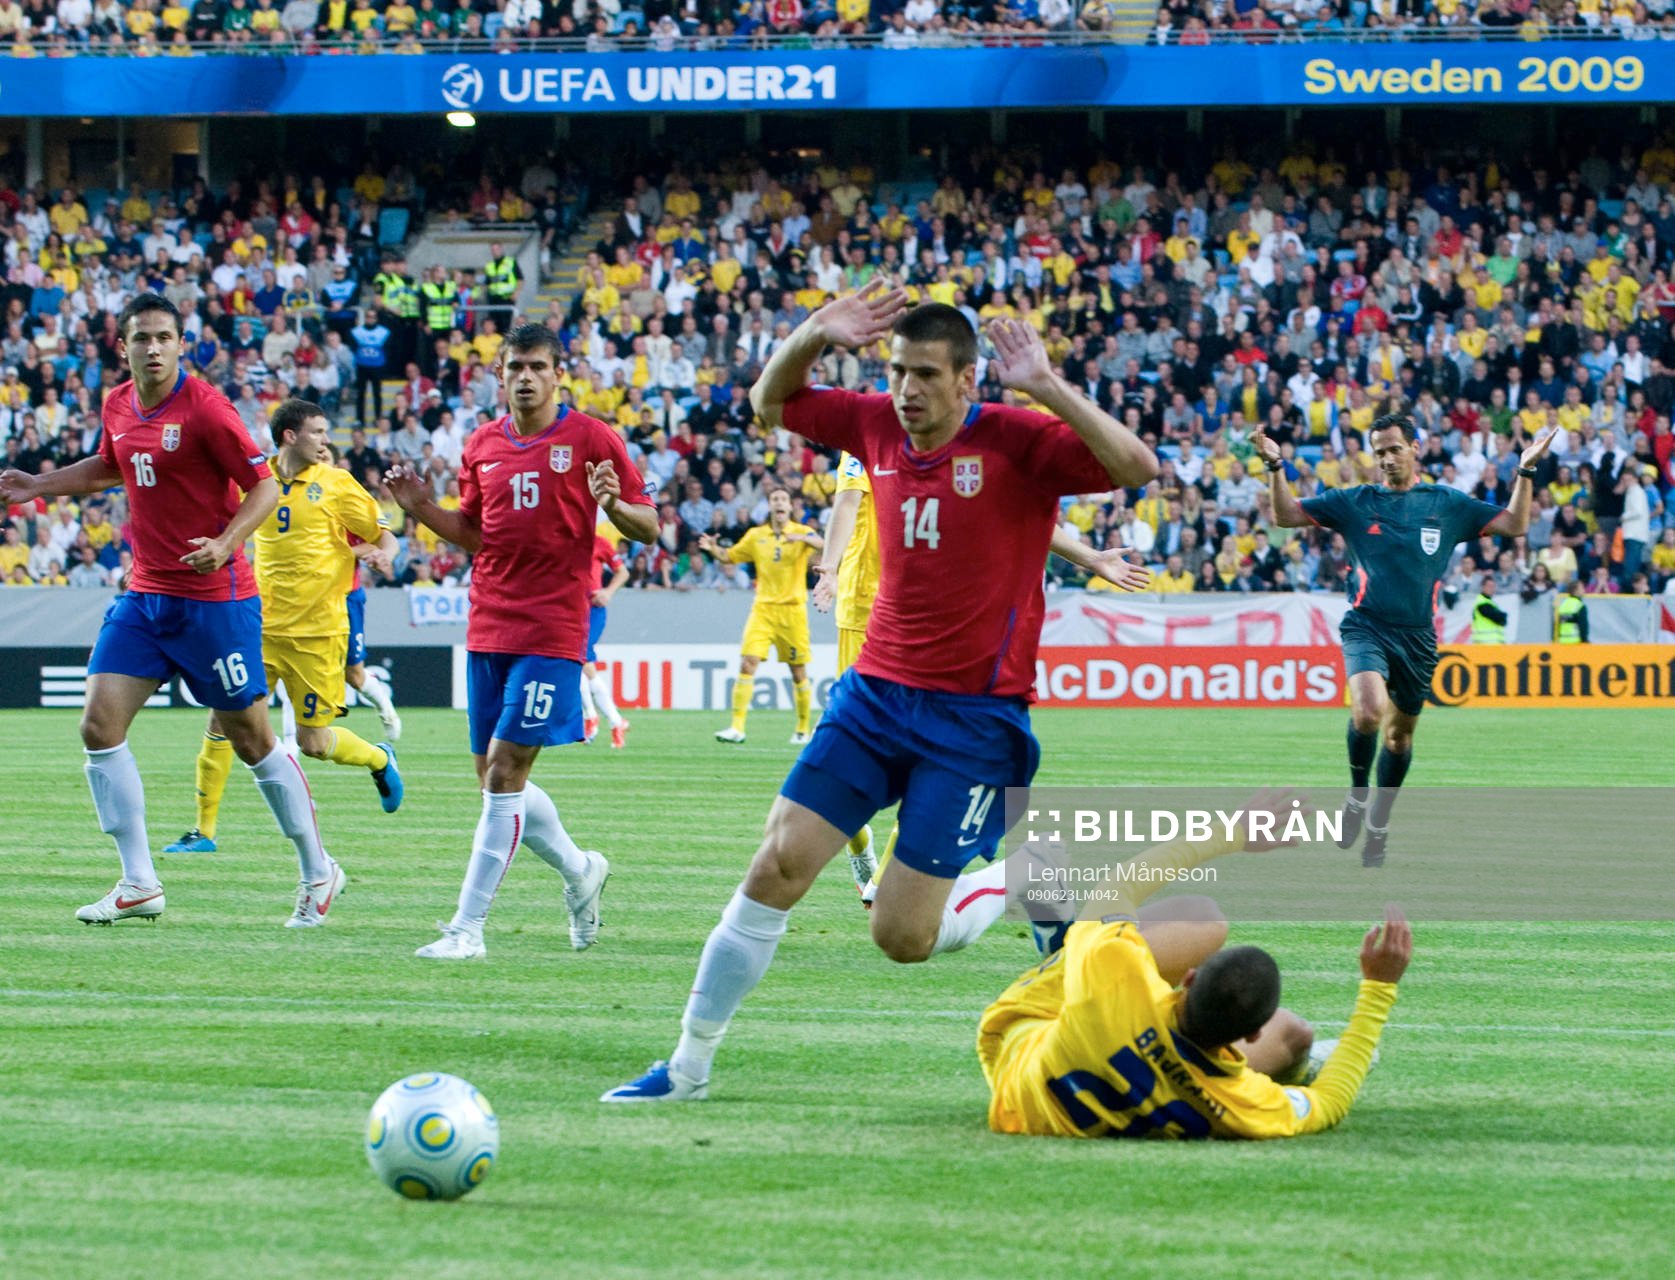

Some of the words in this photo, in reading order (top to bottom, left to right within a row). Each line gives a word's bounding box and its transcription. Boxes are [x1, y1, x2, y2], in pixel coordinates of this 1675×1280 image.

[499, 68, 616, 102] UEFA
[627, 65, 836, 101] UNDER21
[1304, 58, 1502, 94] Sweden
[1517, 56, 1644, 92] 2009
[130, 452, 158, 488] 16
[508, 471, 540, 511] 15
[277, 506, 291, 533] 9
[900, 496, 941, 550] 14
[773, 546, 782, 562] 3
[415, 594, 472, 617] TOI
[212, 652, 249, 691] 16
[788, 646, 798, 661] 3
[523, 680, 556, 720] 15
[595, 660, 673, 709] UI
[303, 693, 317, 719] 9
[960, 784, 998, 835] 14
